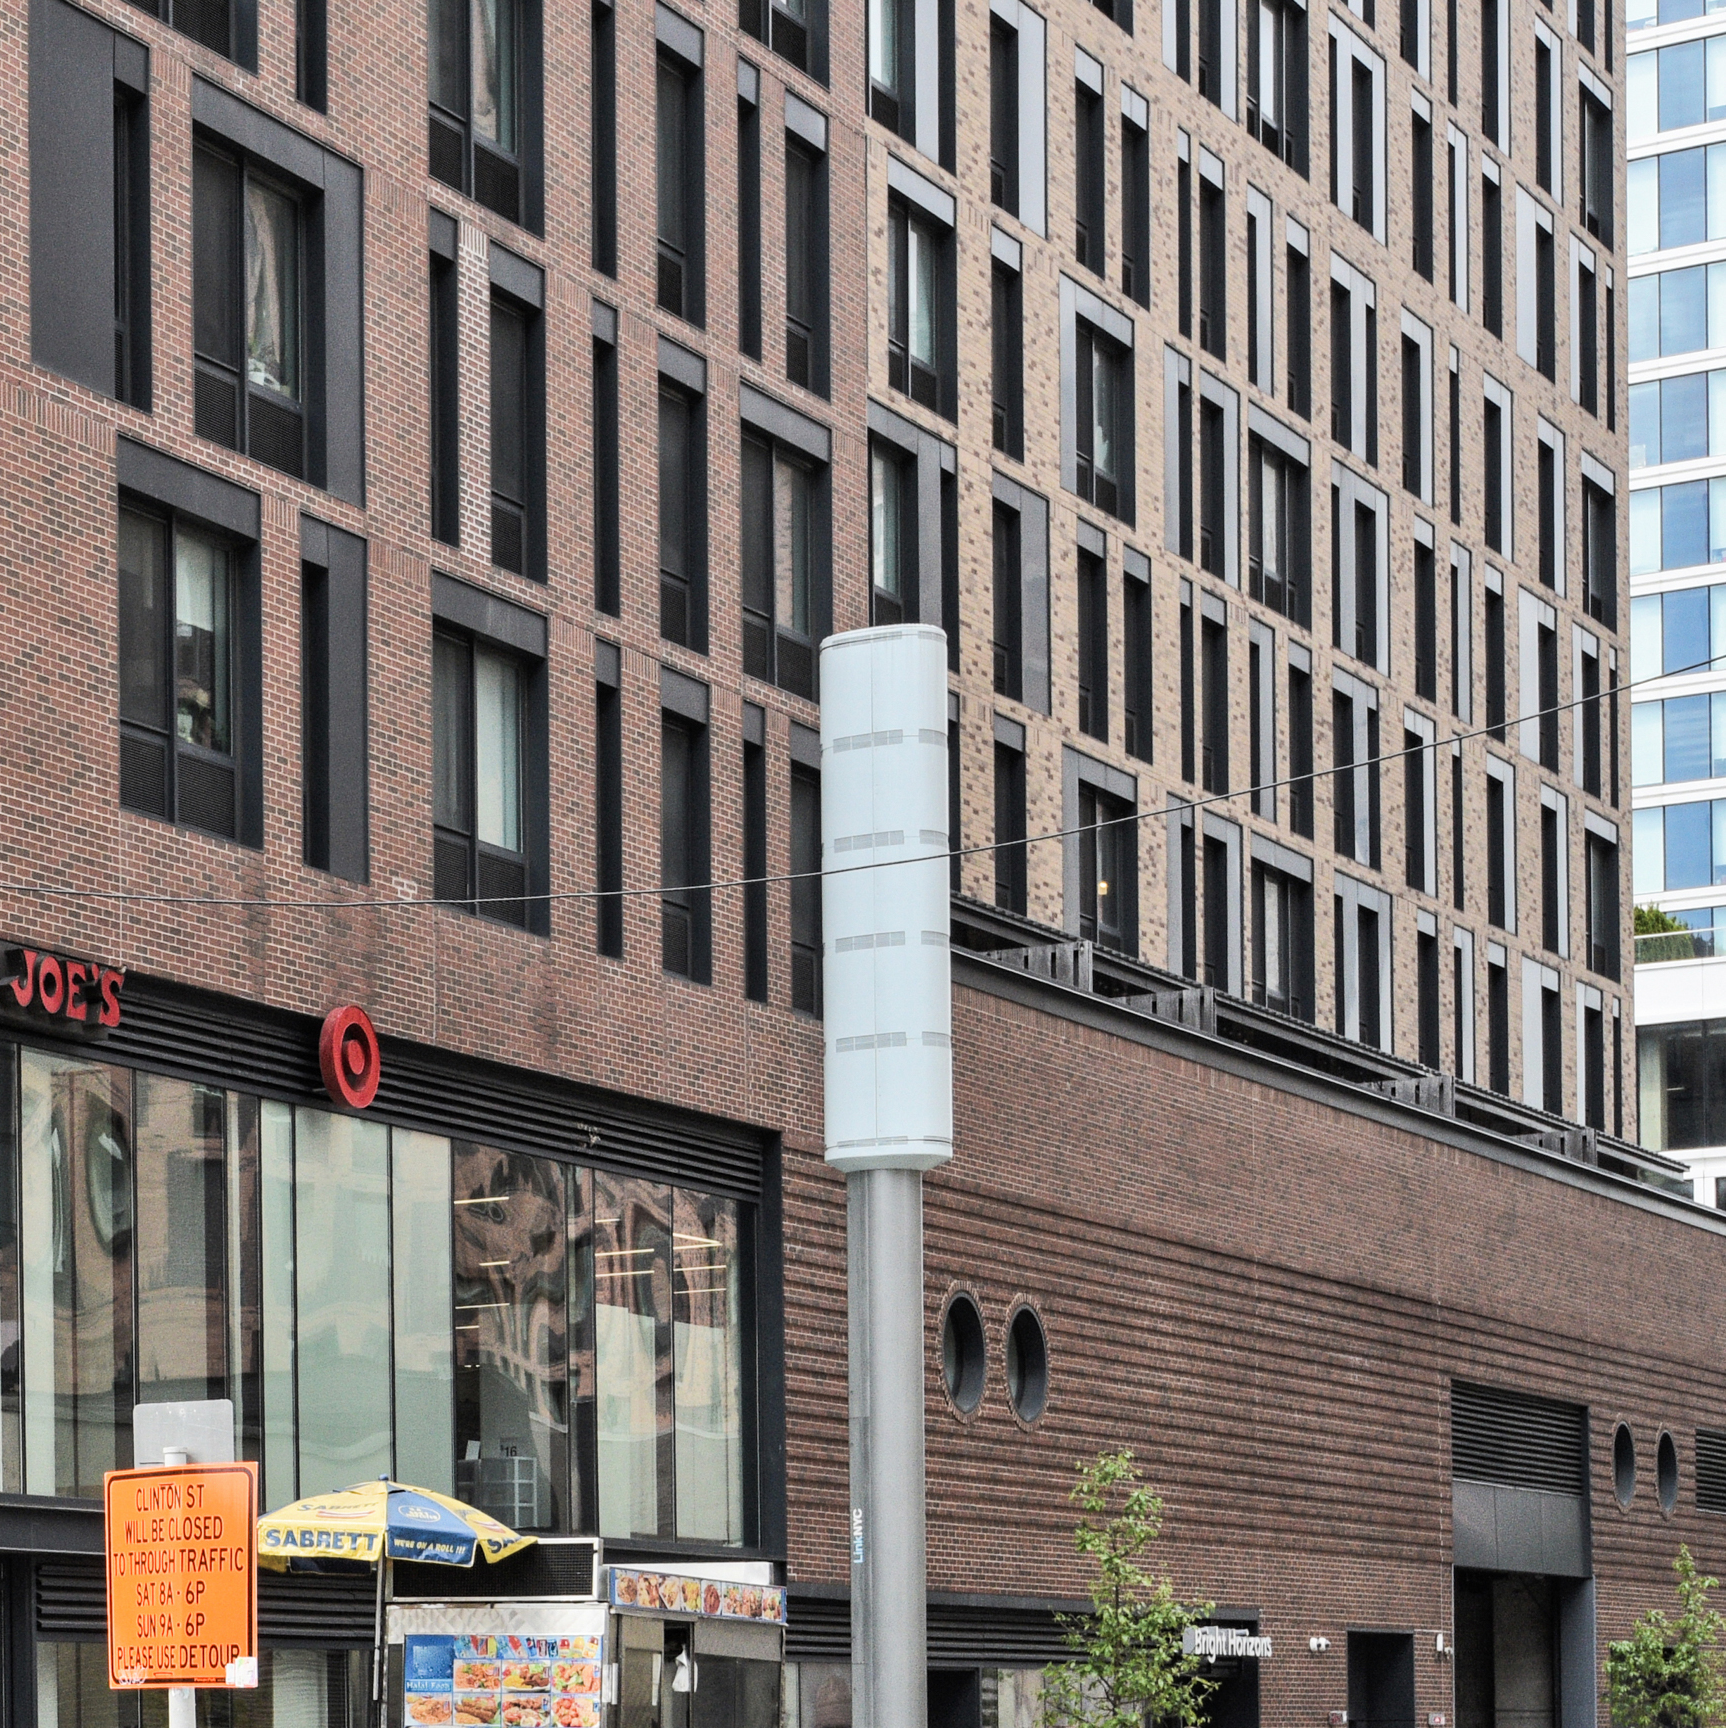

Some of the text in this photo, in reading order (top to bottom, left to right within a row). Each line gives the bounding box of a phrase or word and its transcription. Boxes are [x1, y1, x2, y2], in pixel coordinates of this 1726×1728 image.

[9, 949, 125, 1027] JOE'S
[136, 1484, 205, 1512] CLINTON ST
[124, 1515, 223, 1545] WILL BE CLOSED
[265, 1528, 378, 1551] SABRETT
[852, 1508, 864, 1564] LinkNYC
[416, 1541, 427, 1550] ON
[435, 1543, 454, 1553] ROLL
[113, 1547, 244, 1576] TO THROUGH TRAFFIC
[136, 1582, 155, 1606] SAT
[159, 1581, 174, 1606] 8A
[185, 1580, 205, 1605] 6P
[136, 1613, 156, 1638] SUN
[159, 1613, 174, 1637] 9A
[185, 1612, 205, 1637] 6P
[117, 1644, 240, 1671] PLEASE USE DETOUR
[1194, 1626, 1273, 1663] Bright Horizons
